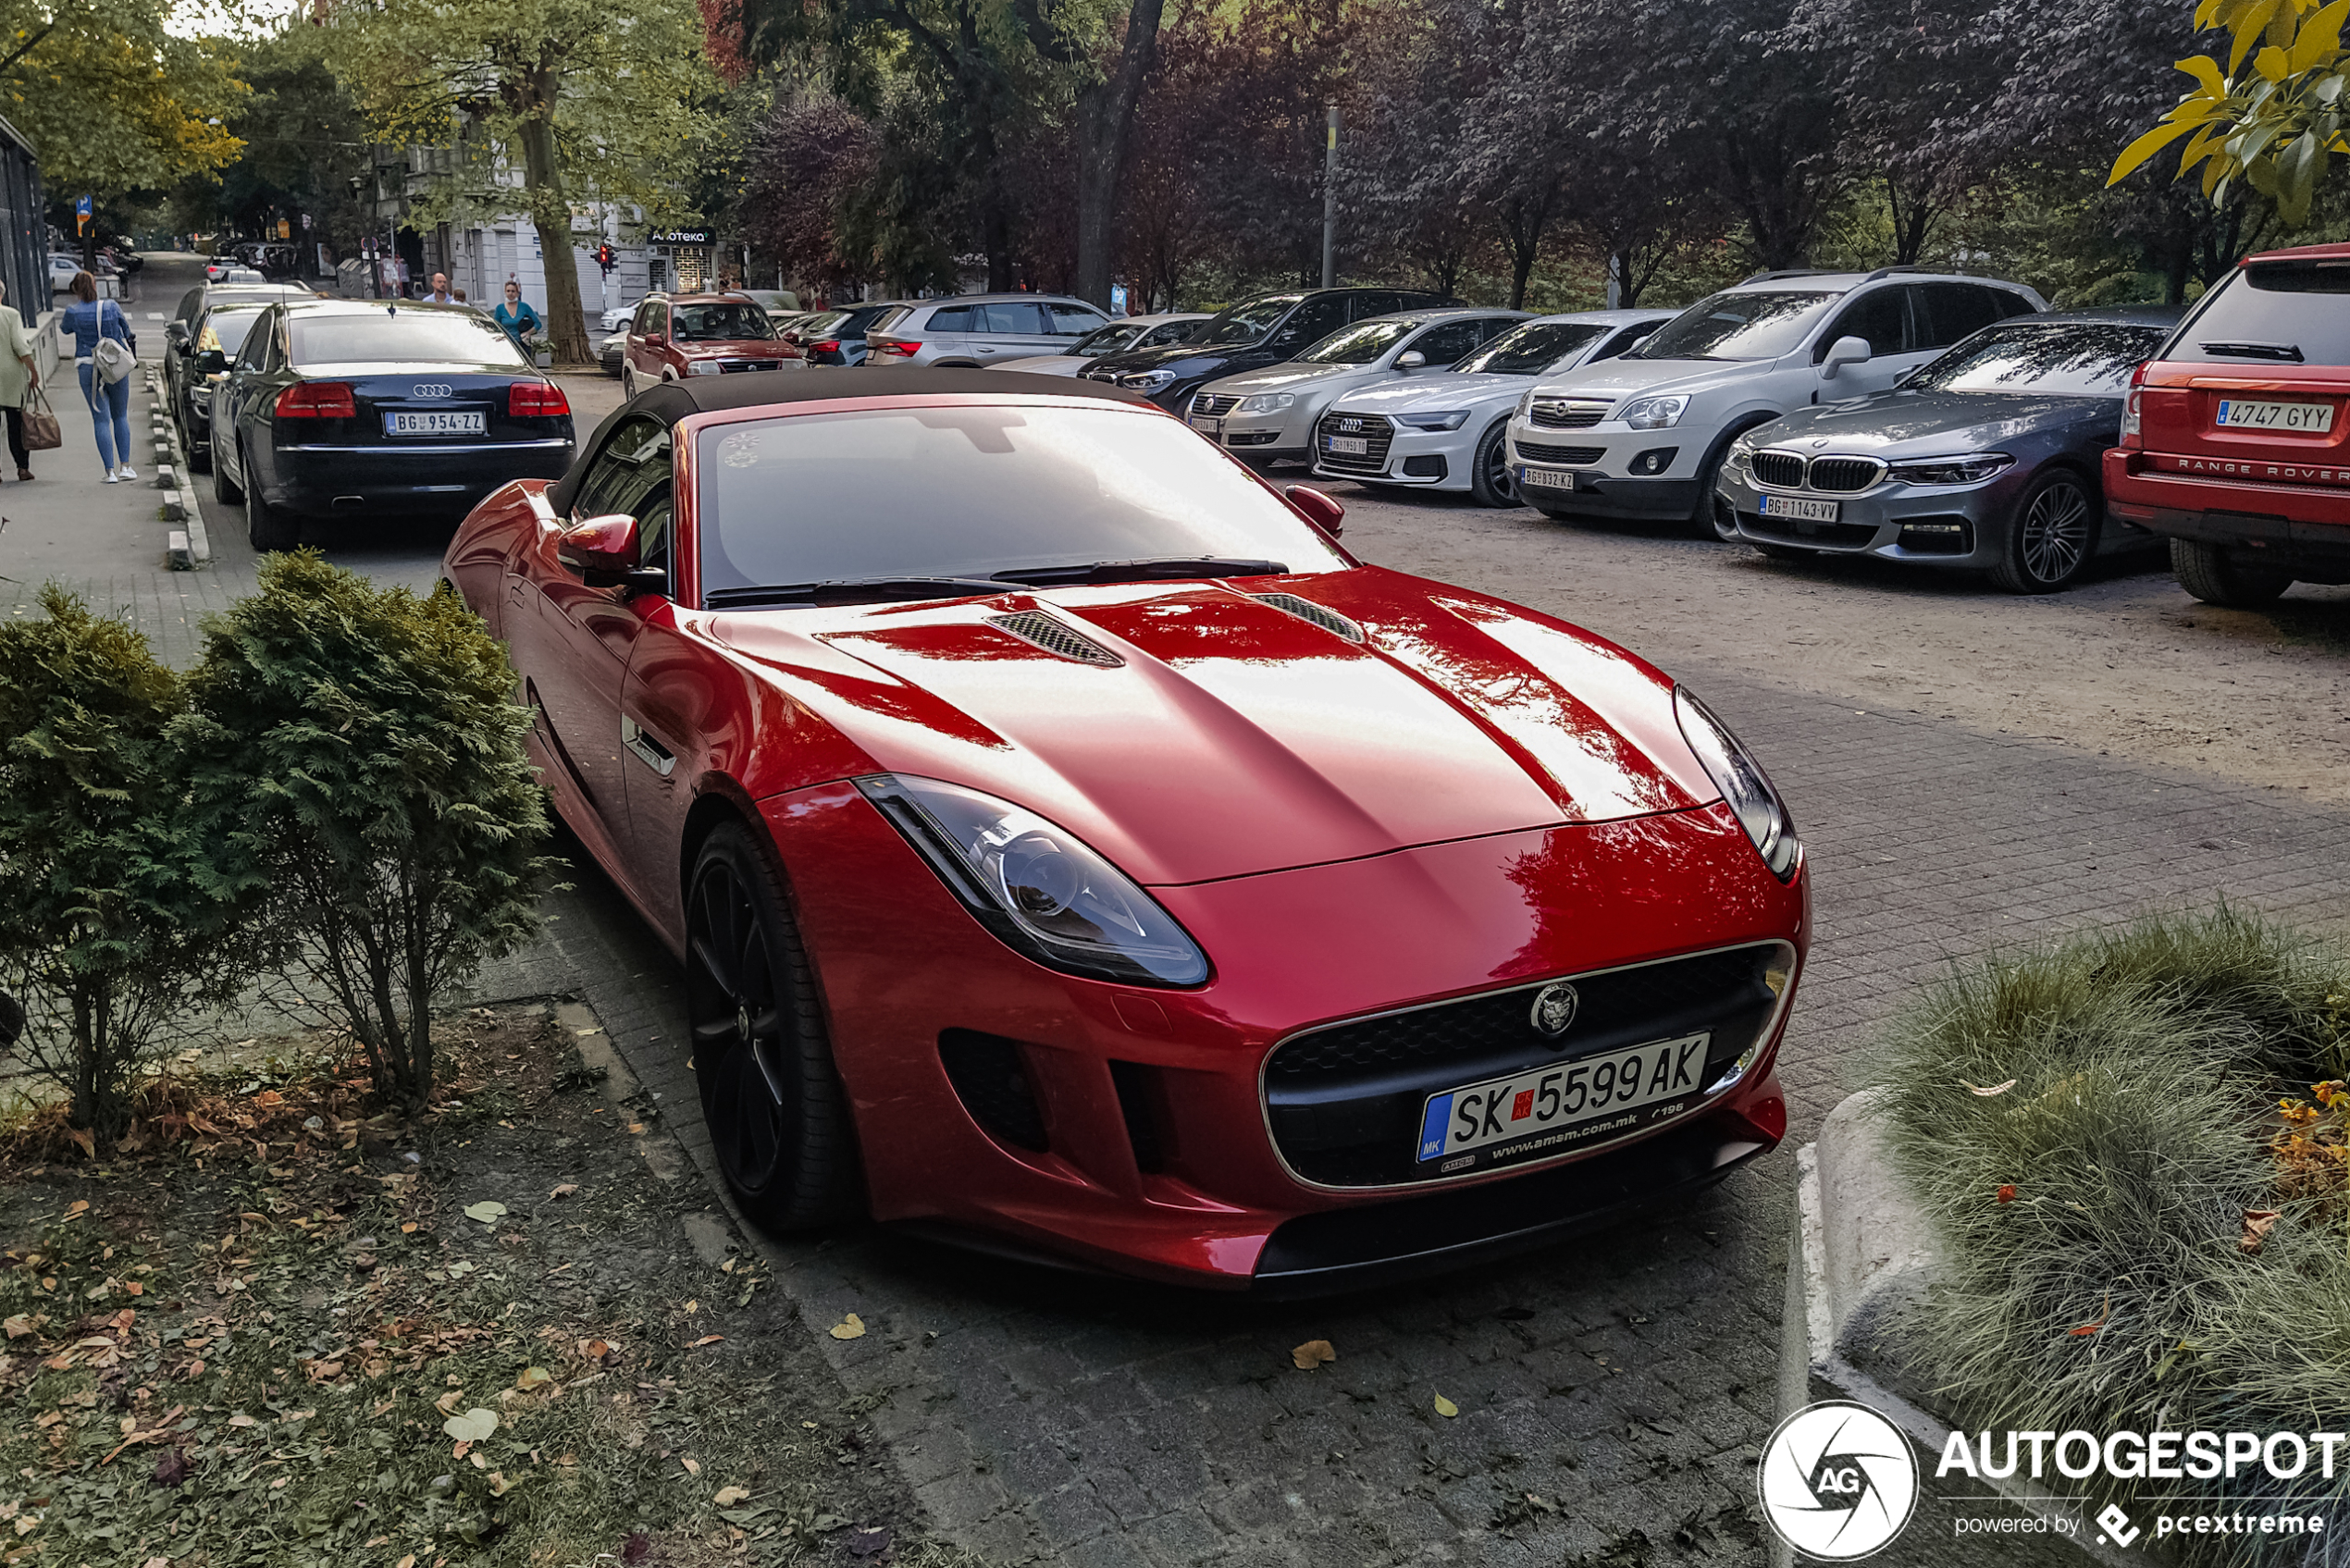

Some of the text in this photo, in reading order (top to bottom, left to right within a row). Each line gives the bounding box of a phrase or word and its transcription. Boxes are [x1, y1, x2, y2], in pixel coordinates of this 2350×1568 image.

[398, 415, 416, 430] BG
[2231, 405, 2328, 428] 4747 GYY
[1527, 470, 1537, 482] BG
[2179, 459, 2350, 481] RANGE ROVER
[1768, 499, 1781, 514] BG
[1453, 1040, 1701, 1142] SK 5599 AK
[1492, 1103, 1684, 1159] www.amsm.com.mk 196
[1423, 1139, 1441, 1154] MK
